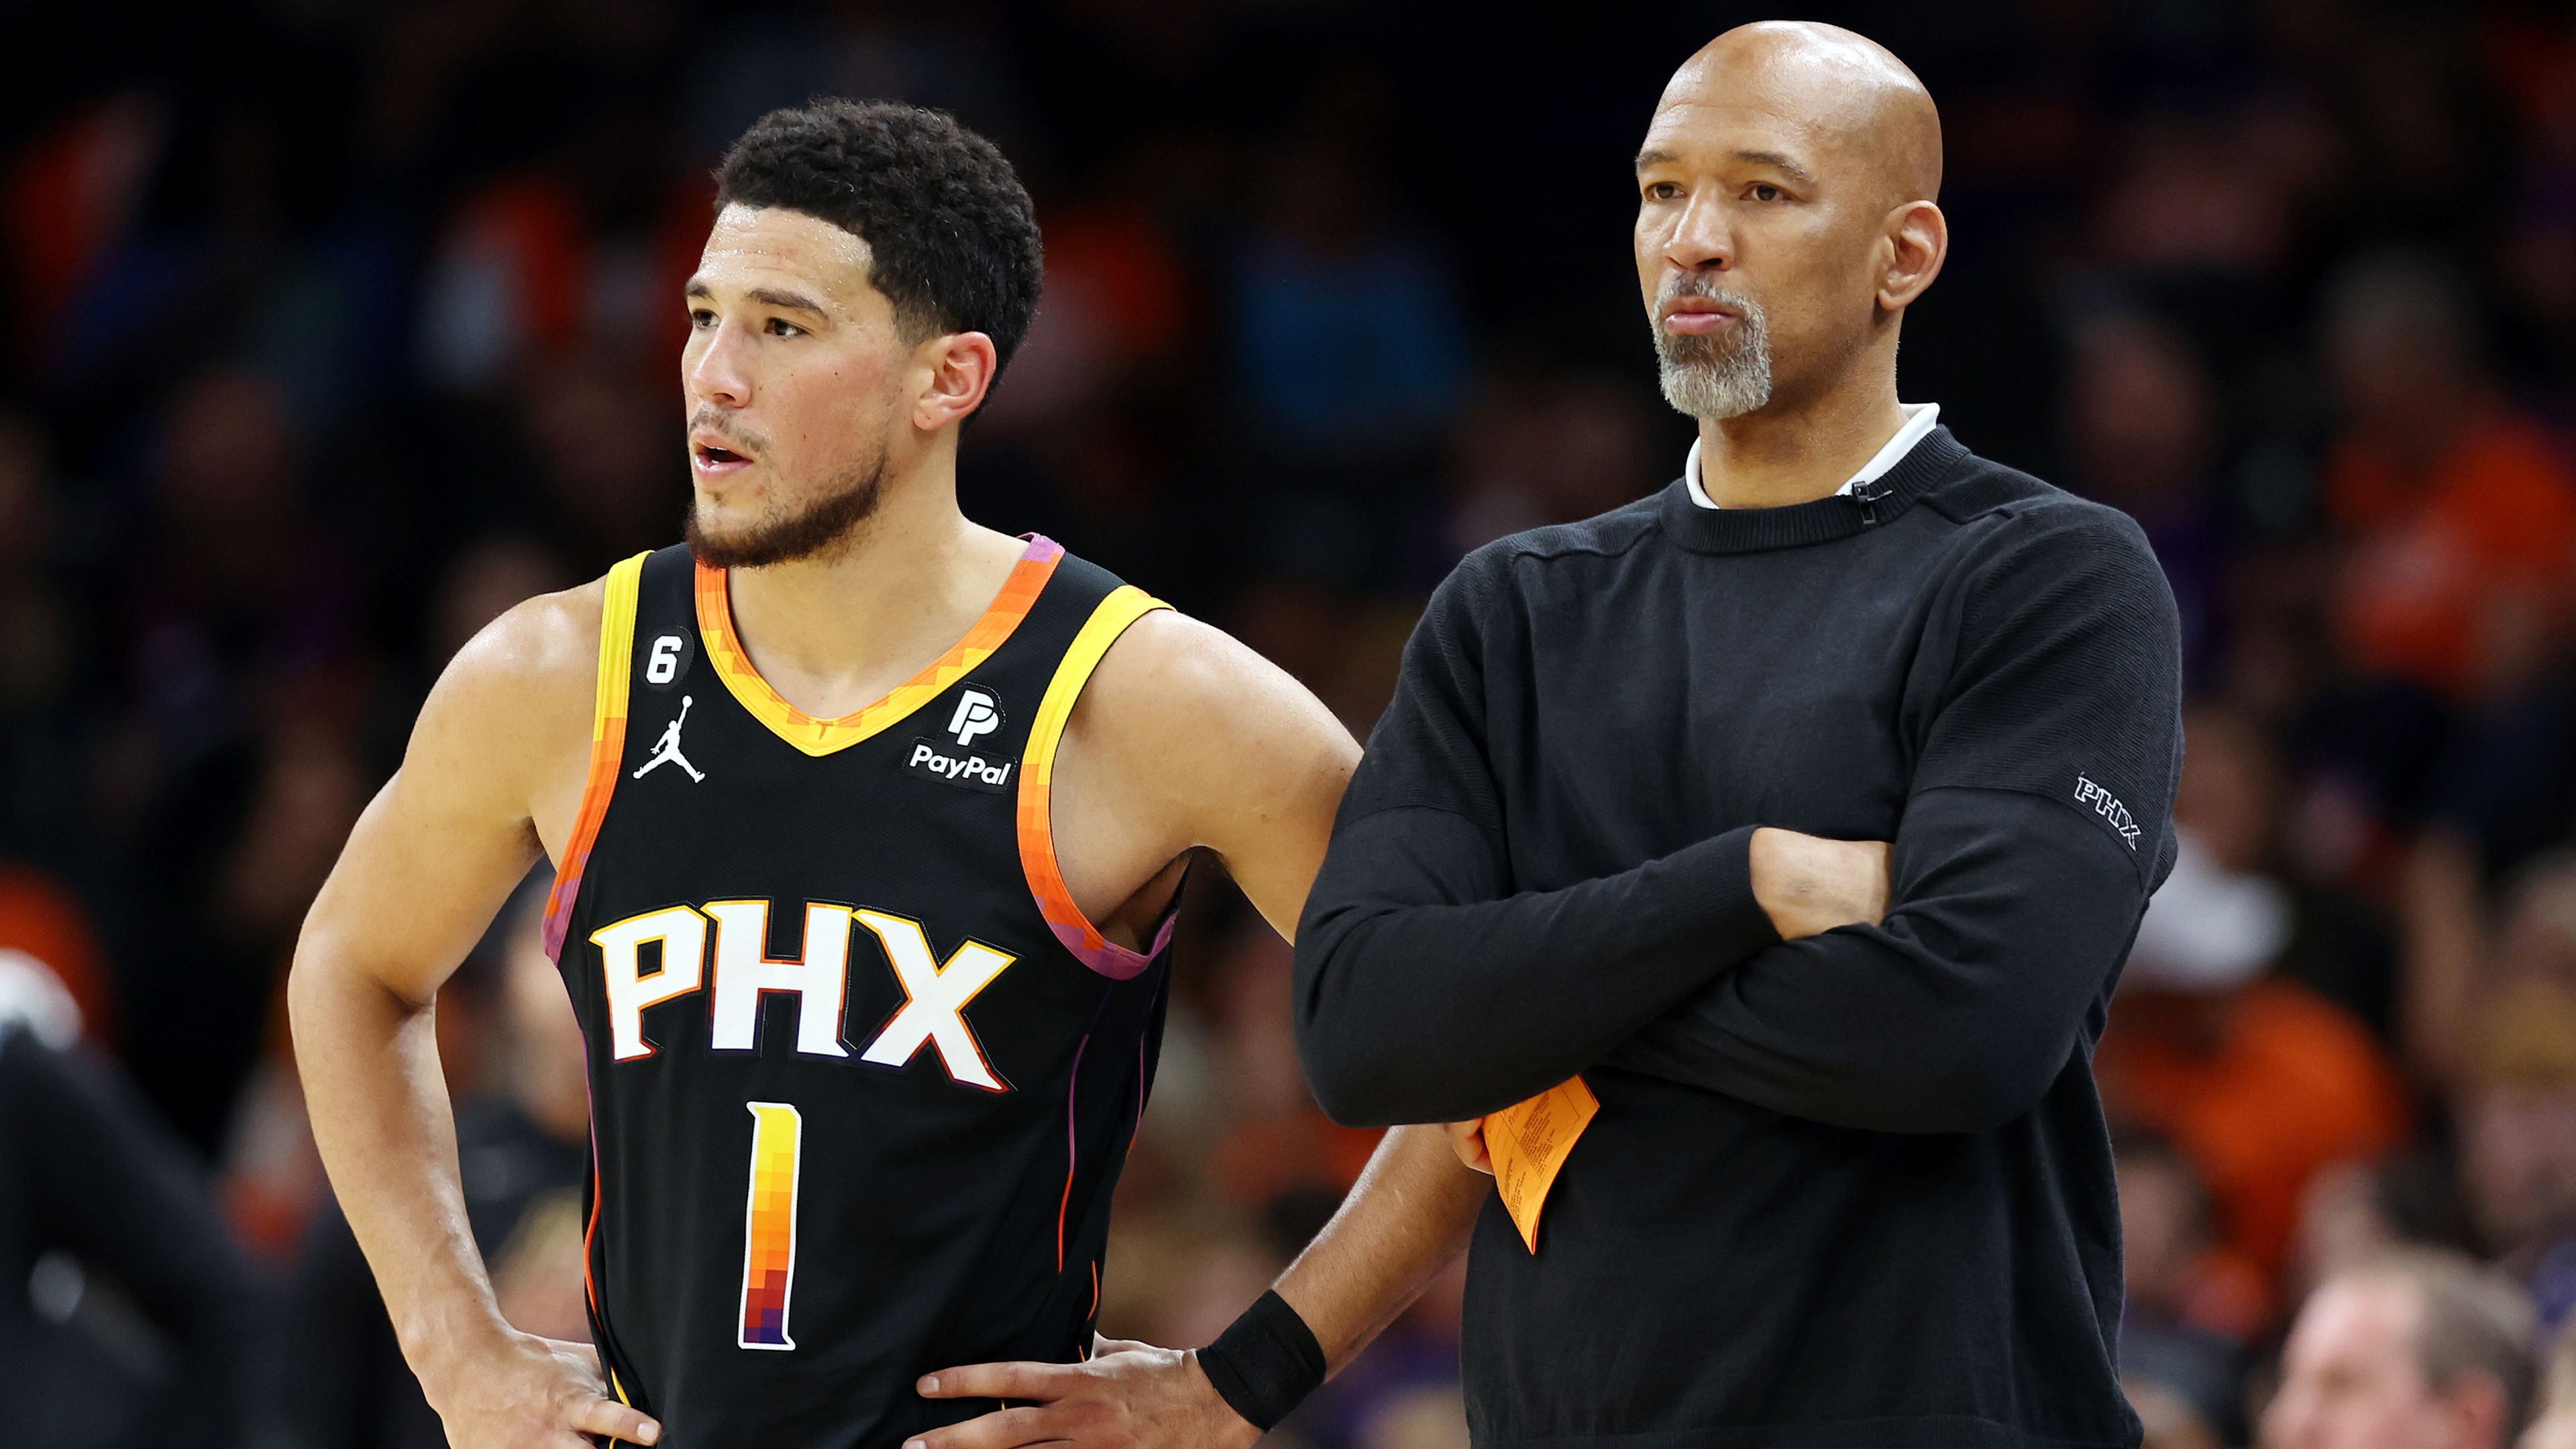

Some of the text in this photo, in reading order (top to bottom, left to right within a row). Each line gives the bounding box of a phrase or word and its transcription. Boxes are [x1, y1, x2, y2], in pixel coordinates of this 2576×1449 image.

[646, 635, 683, 684] 6
[909, 744, 1012, 786] PayPal
[2074, 776, 2141, 851] PHX
[589, 900, 1018, 1093] PHX
[739, 1101, 802, 1350] 1
